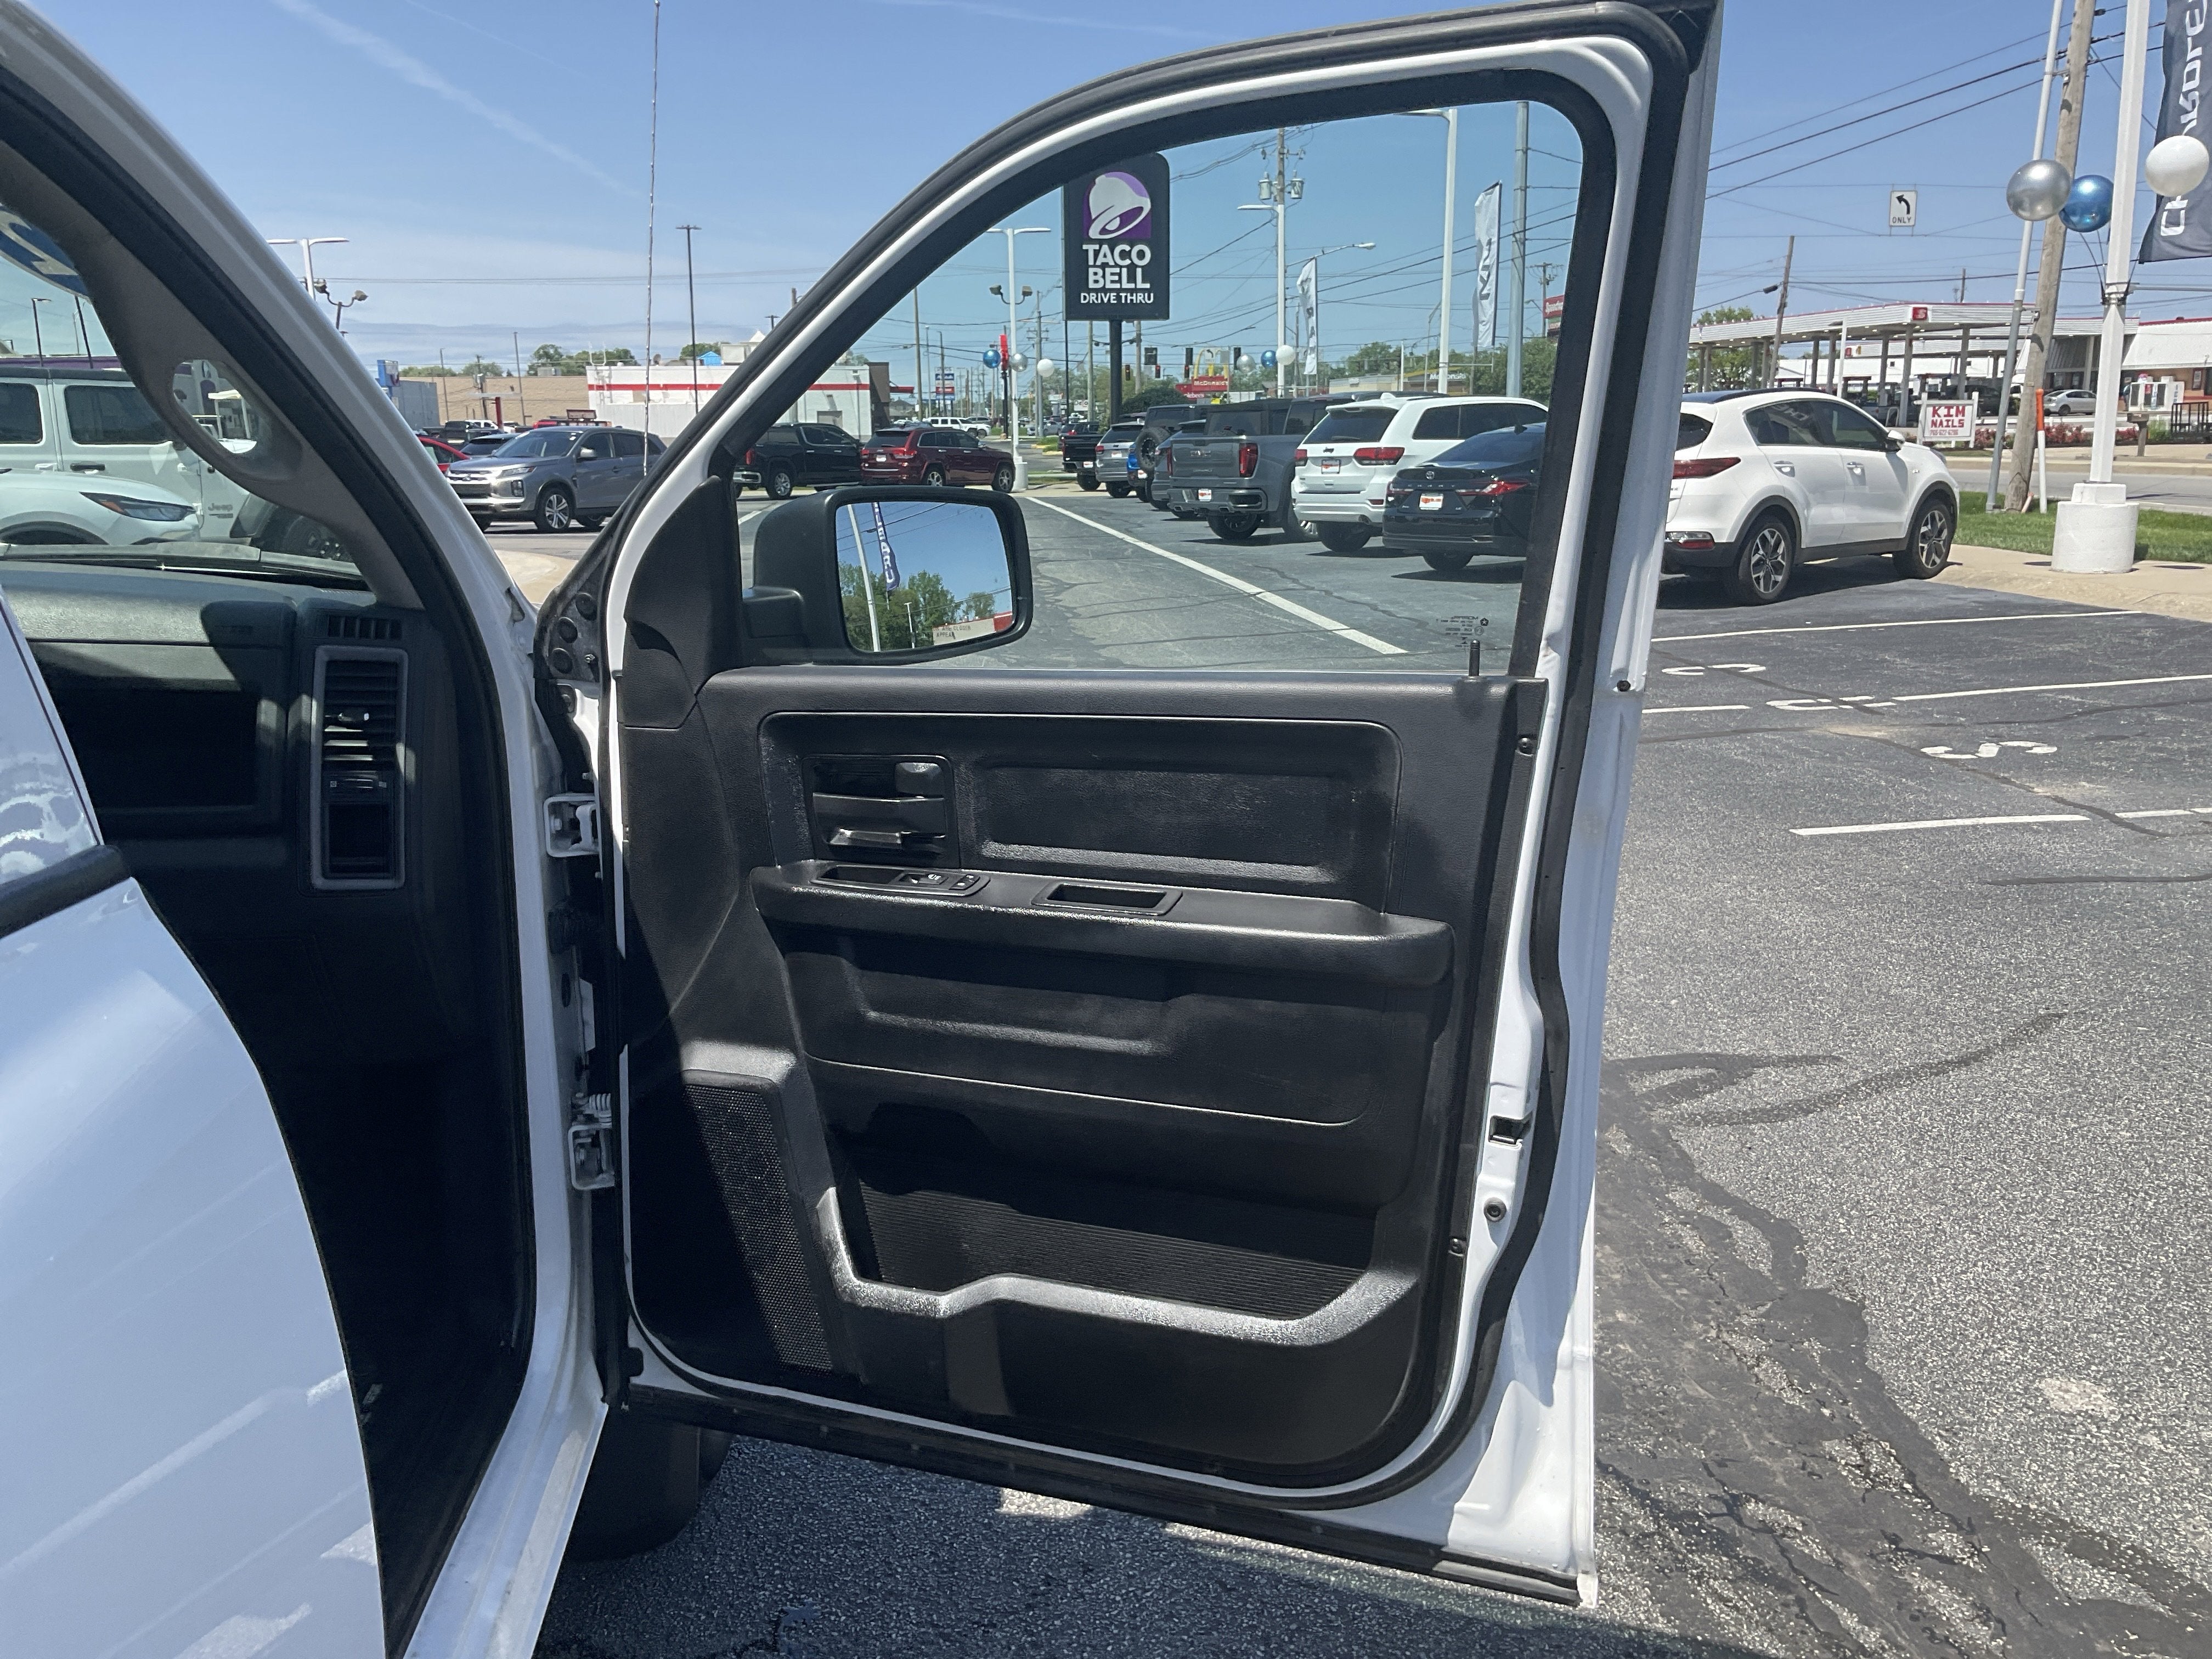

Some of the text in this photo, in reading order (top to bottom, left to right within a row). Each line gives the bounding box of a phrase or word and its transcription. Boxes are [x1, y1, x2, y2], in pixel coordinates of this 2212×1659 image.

[1082, 245, 1152, 266] TACO
[1088, 268, 1150, 289] BELL
[1081, 292, 1154, 304] DRIVE THRU
[1932, 405, 1966, 417] KIM
[1931, 419, 1965, 428] NAILS
